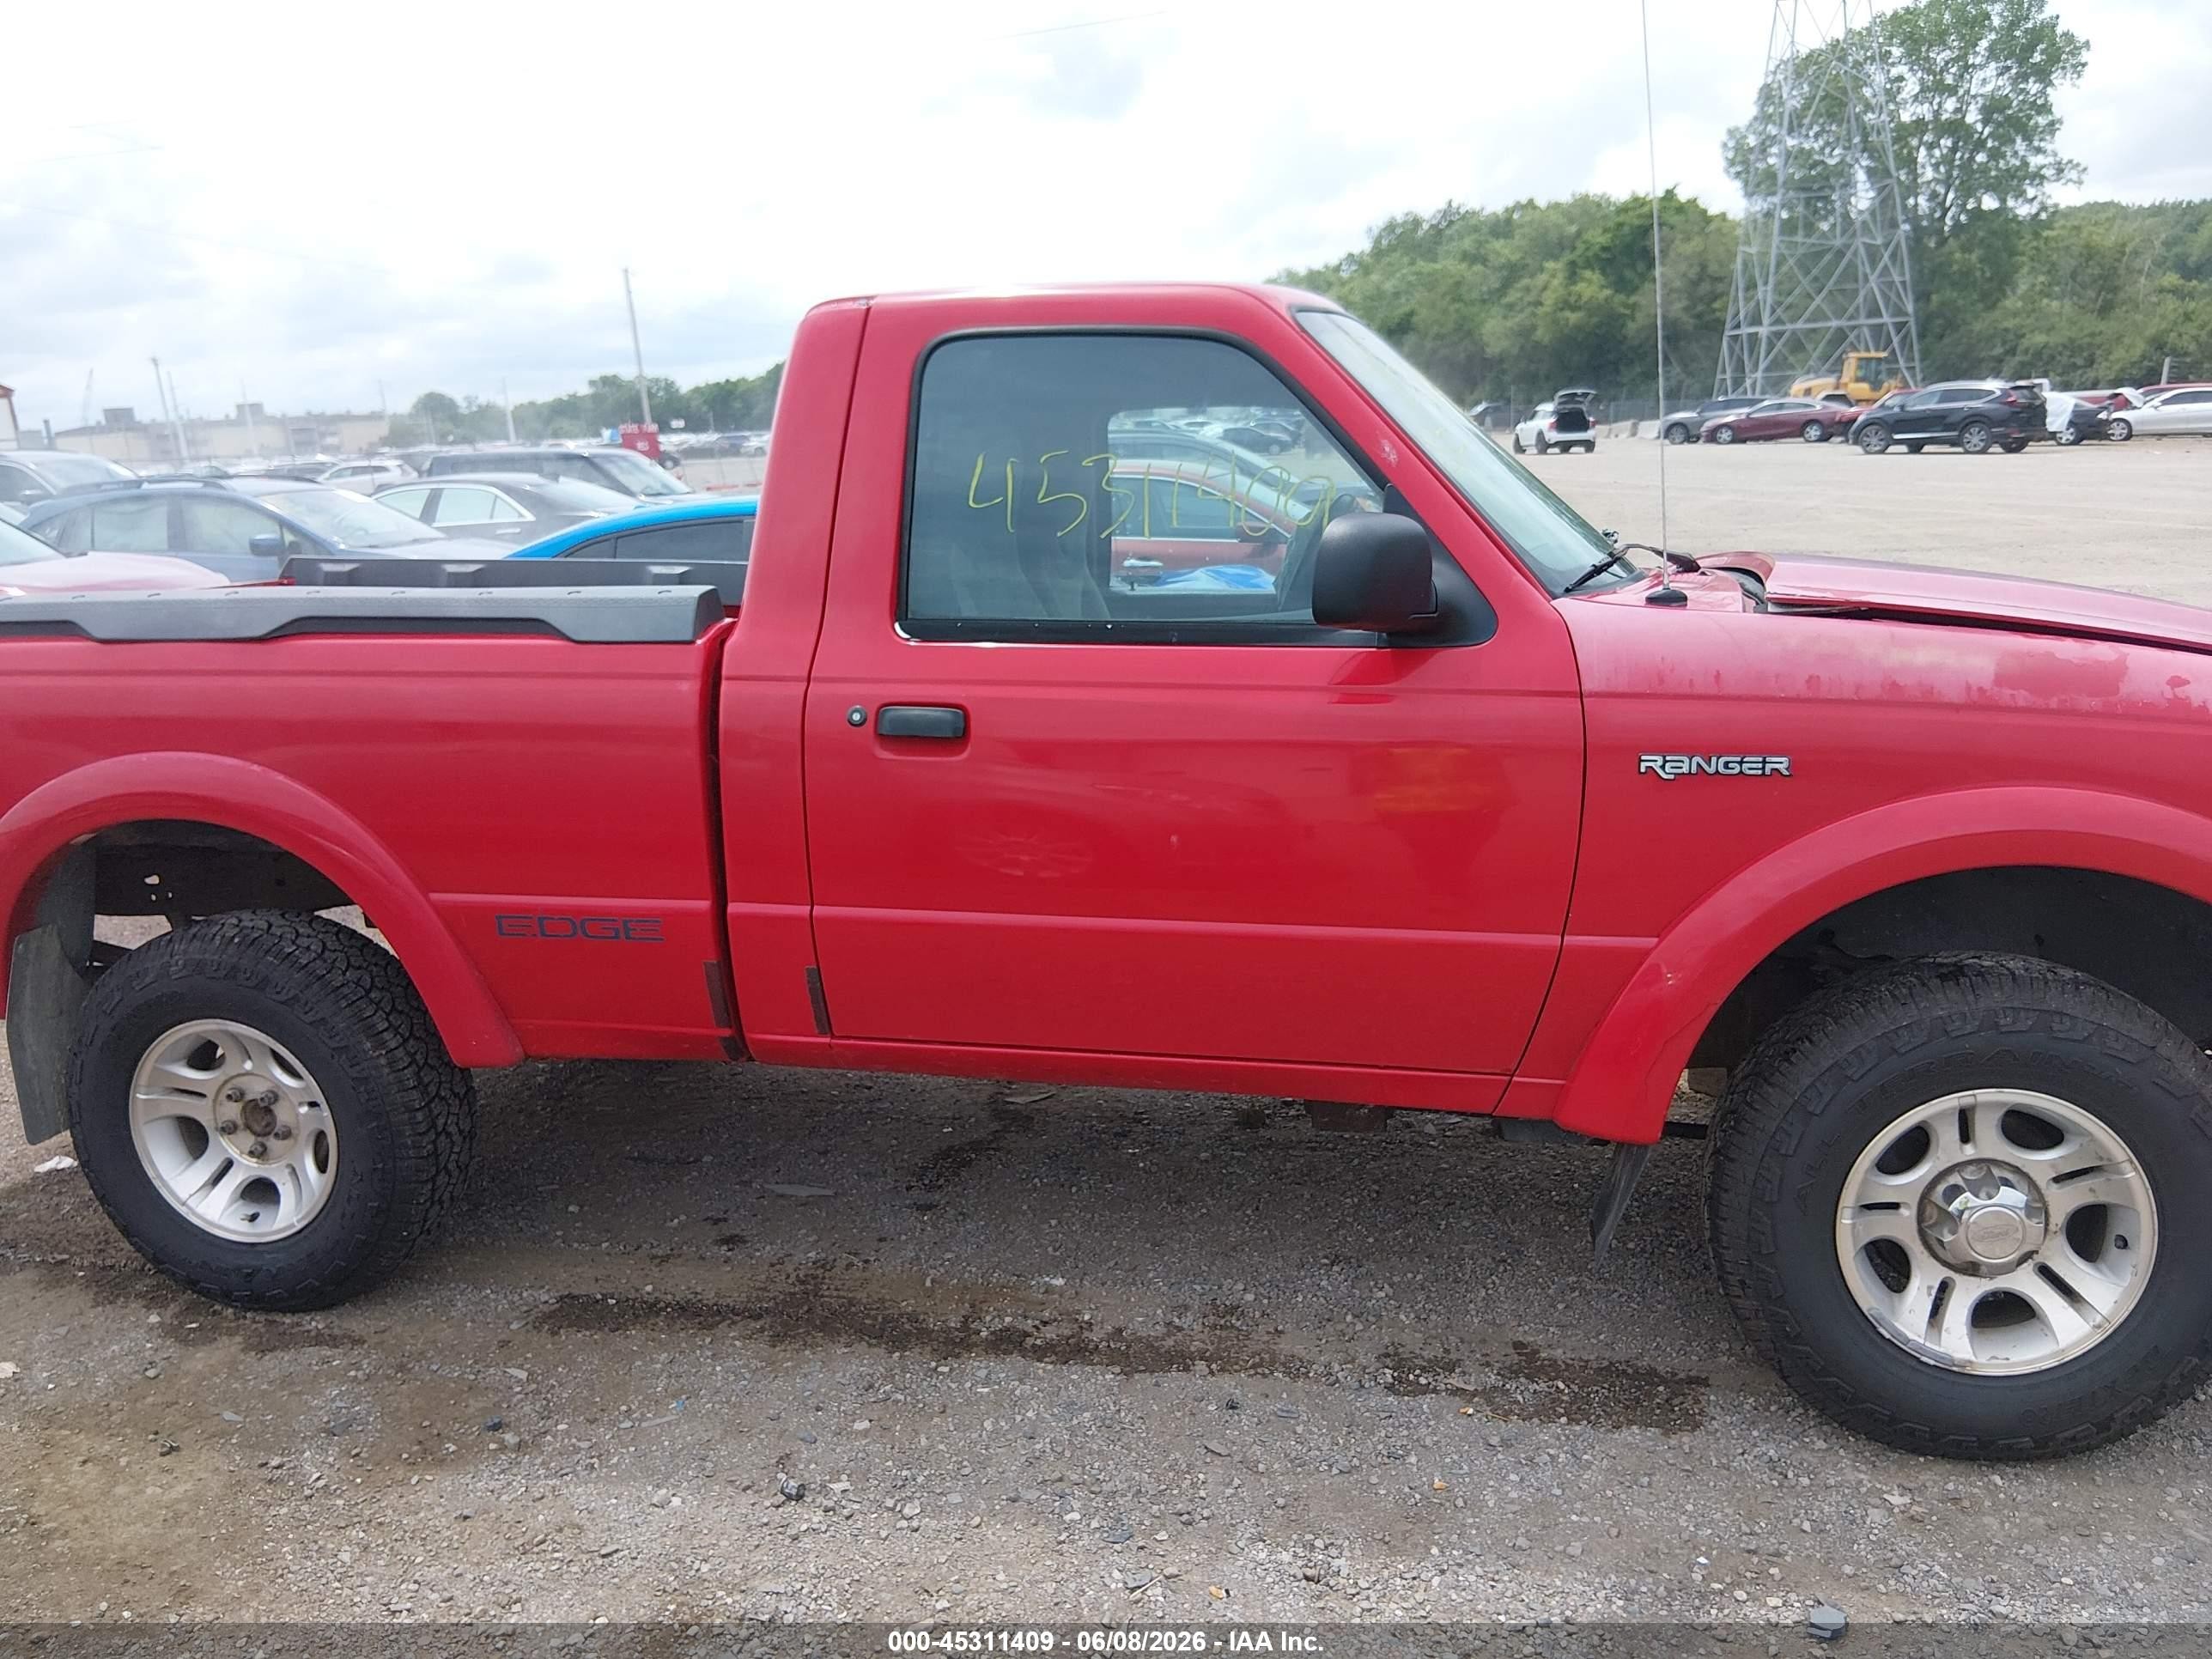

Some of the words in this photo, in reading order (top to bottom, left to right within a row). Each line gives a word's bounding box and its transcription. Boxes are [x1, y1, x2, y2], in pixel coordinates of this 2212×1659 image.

[968, 449, 1336, 538] 45311409
[1639, 754, 1792, 780] RANGER
[495, 915, 665, 942] EDGE
